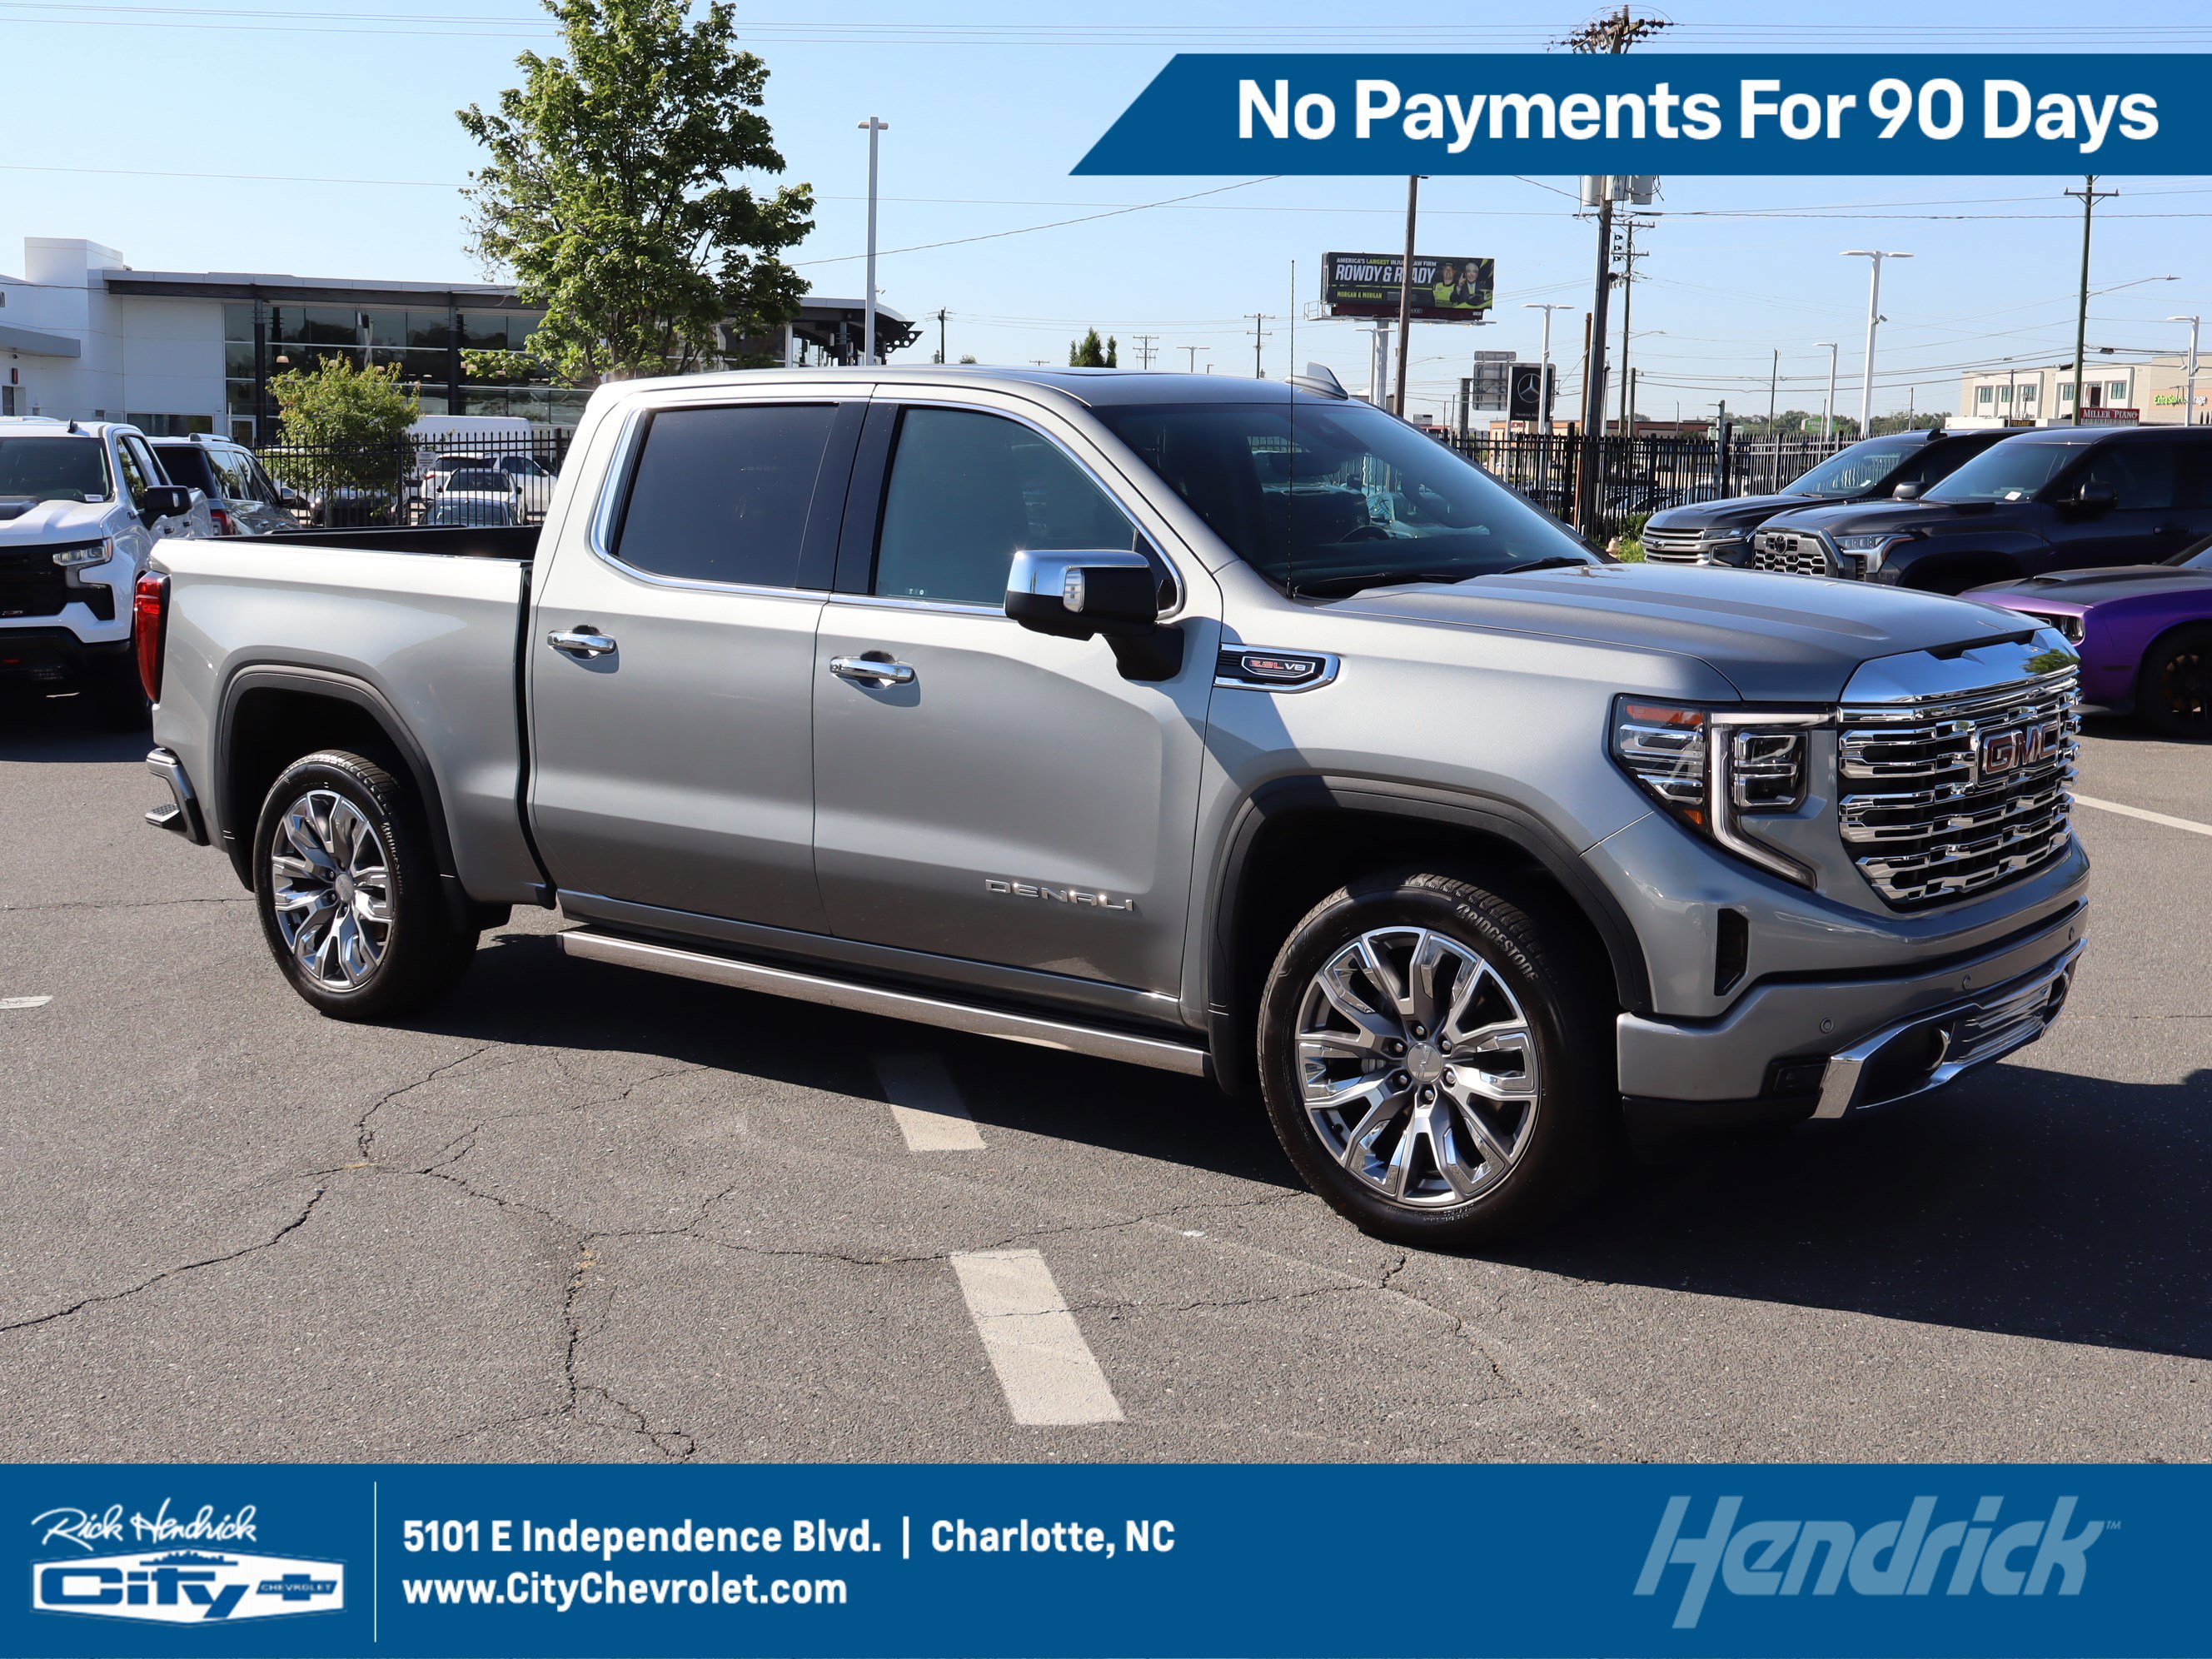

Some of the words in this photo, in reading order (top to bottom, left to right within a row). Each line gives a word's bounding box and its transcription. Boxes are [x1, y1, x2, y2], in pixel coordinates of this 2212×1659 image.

[1335, 264, 1382, 281] ROWDY
[1382, 265, 1392, 282] &
[1393, 267, 1437, 284] RADY
[2082, 409, 2110, 418] MILLER
[2114, 410, 2139, 419] PIANO
[1284, 663, 1307, 671] V8
[1983, 720, 2058, 775] GMC
[984, 878, 1134, 912] DENALI
[1454, 902, 1540, 982] BRIDGESTONE
